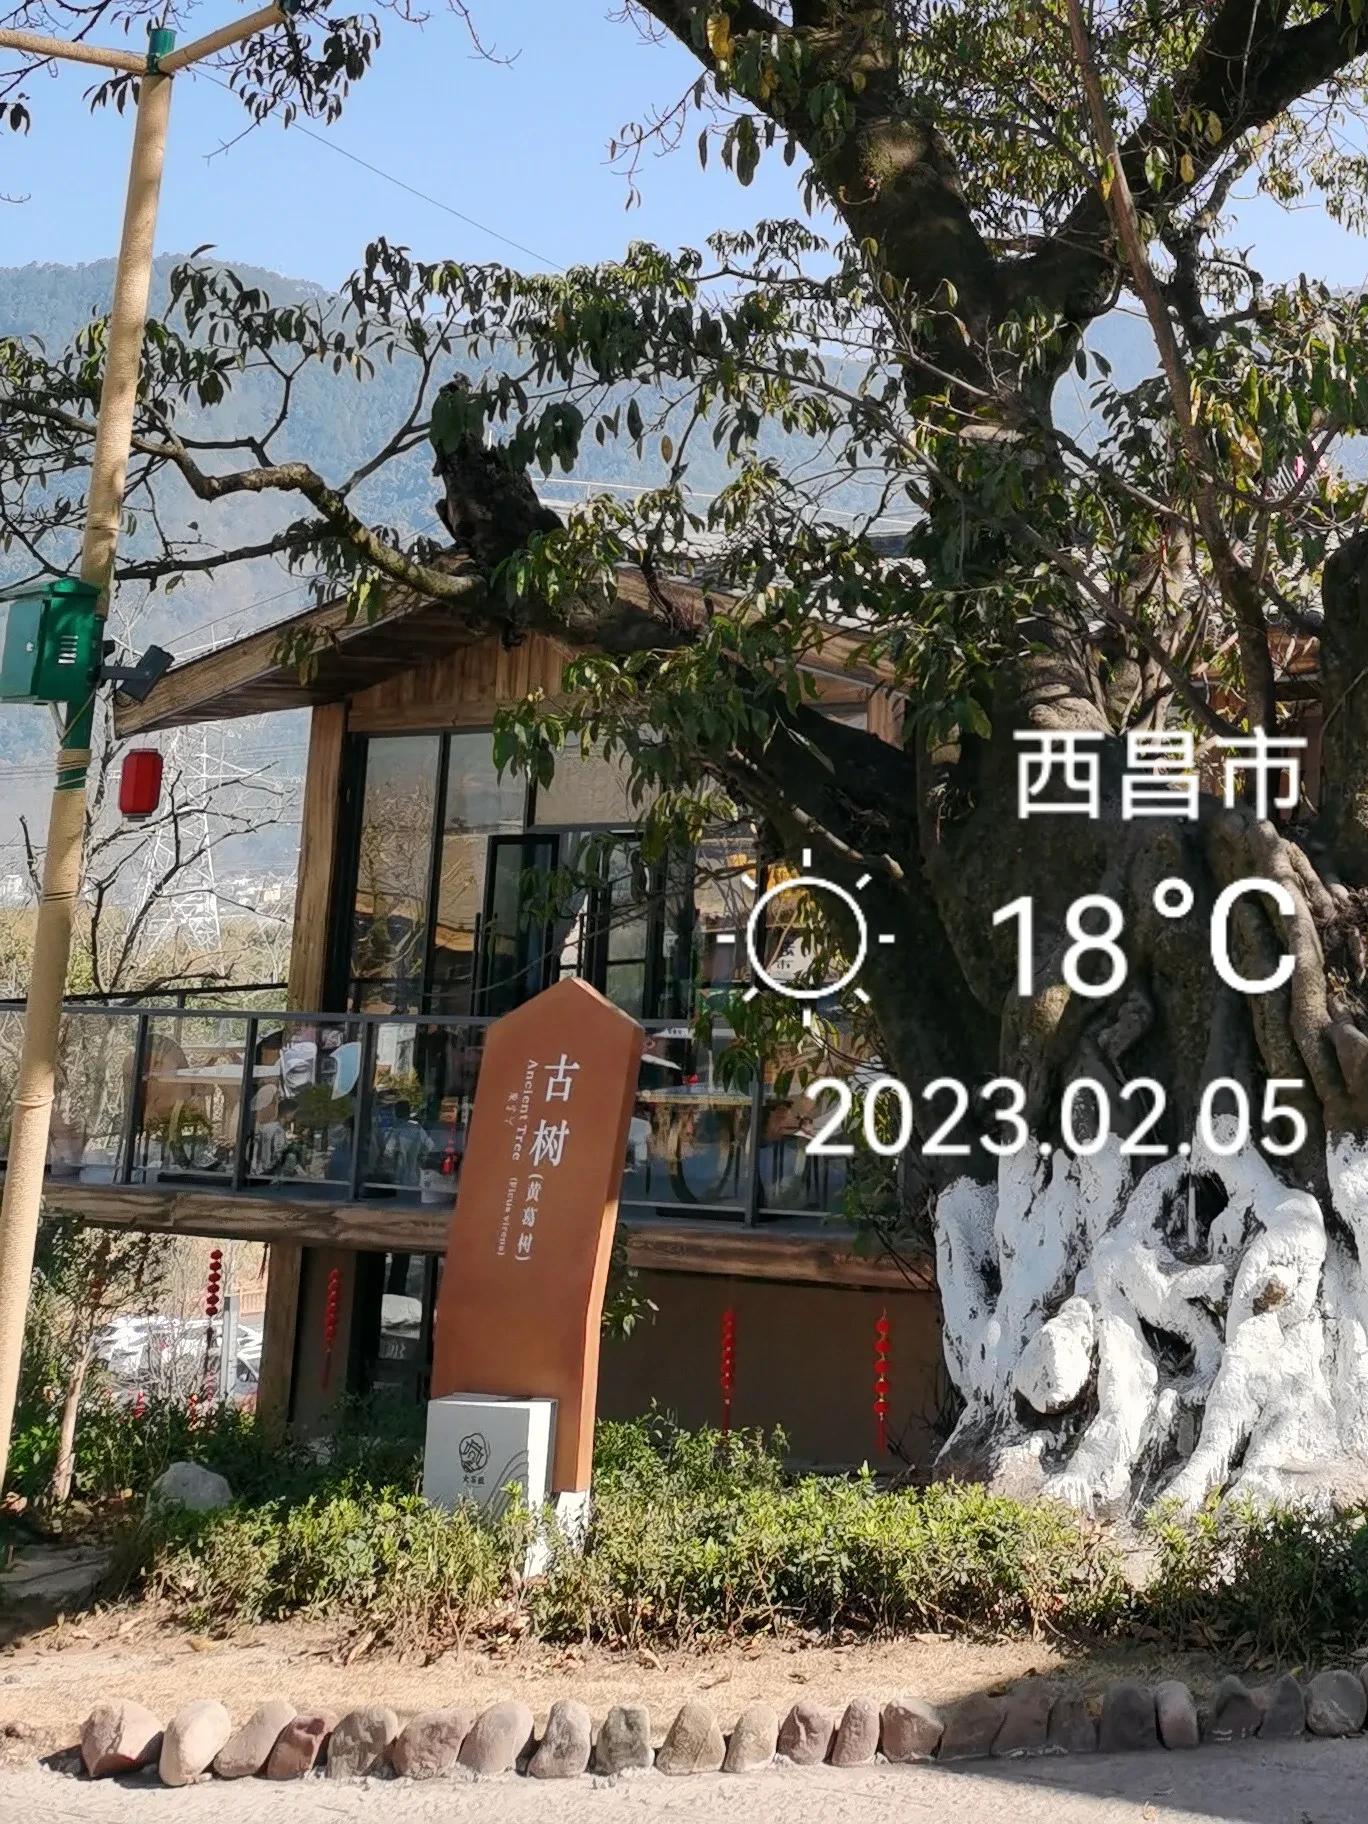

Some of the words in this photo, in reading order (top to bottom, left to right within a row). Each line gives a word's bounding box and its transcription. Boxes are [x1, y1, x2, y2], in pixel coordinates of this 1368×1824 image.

[519, 1058, 539, 1121] Ancient
[528, 1052, 582, 1167] 古树
[511, 1124, 528, 1161] Tree
